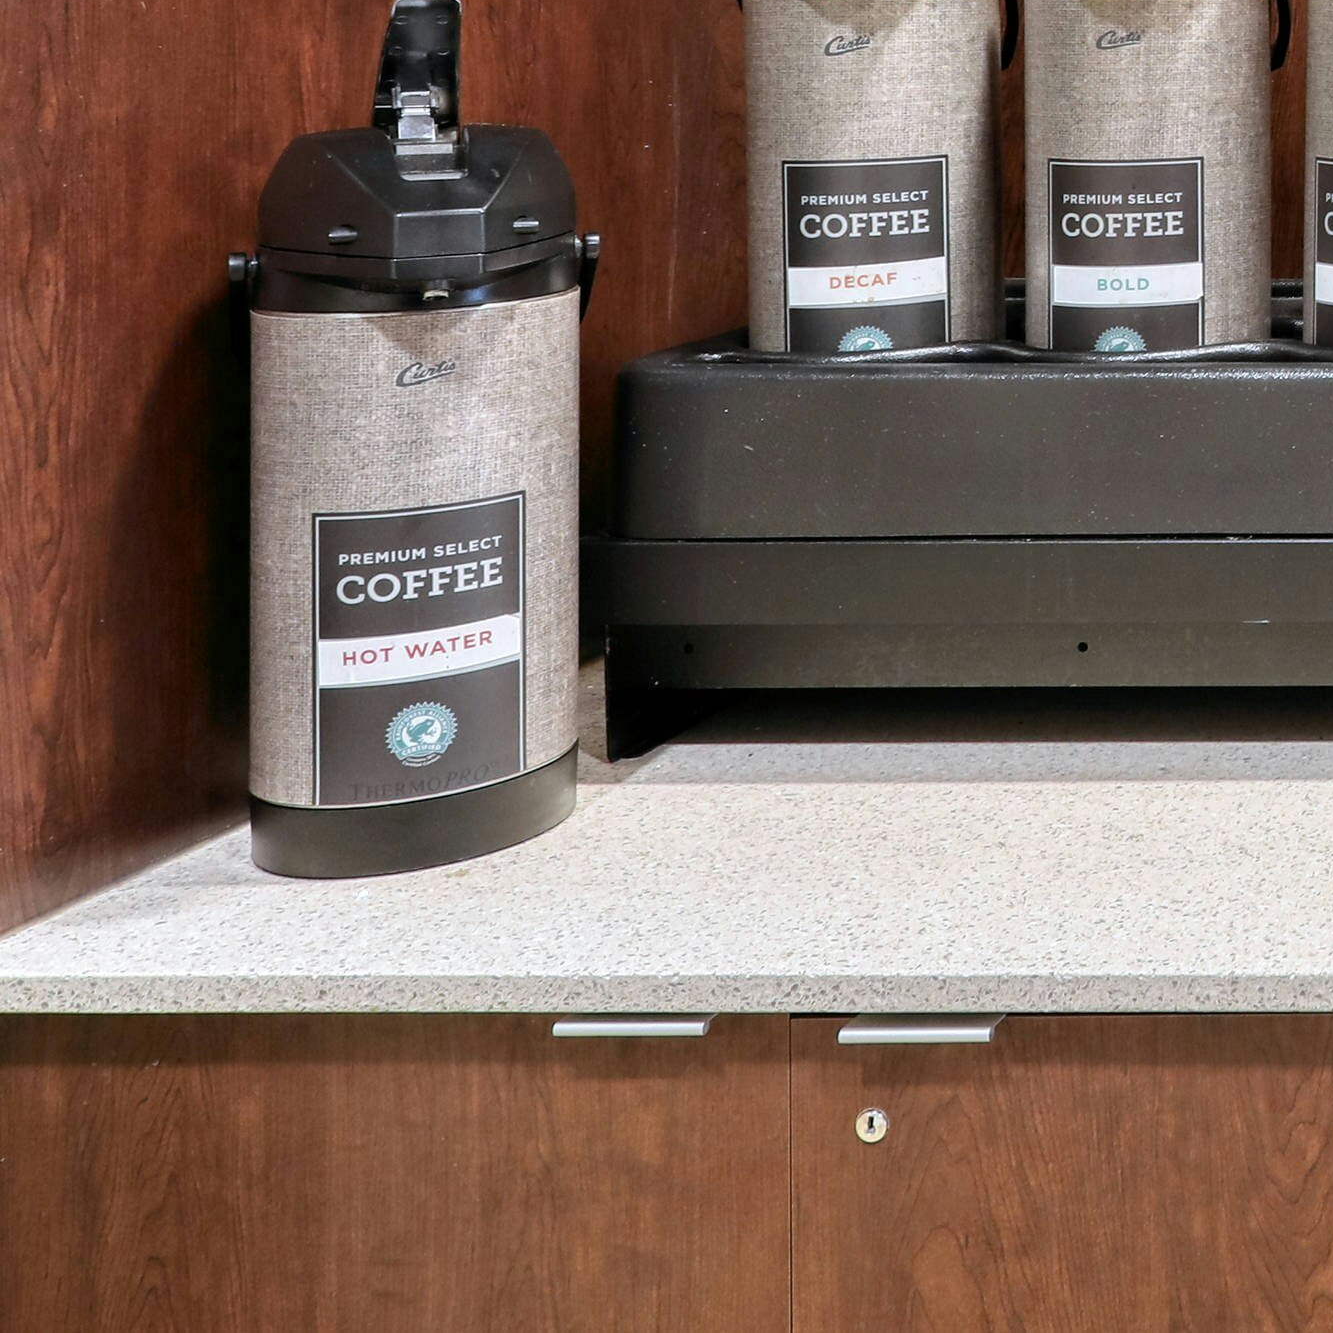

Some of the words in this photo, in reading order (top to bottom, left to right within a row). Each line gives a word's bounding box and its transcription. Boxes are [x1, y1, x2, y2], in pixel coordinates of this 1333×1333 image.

[823, 35, 871, 57] Curtis
[1096, 30, 1142, 50] Curtis
[800, 193, 867, 206] PREMIUM
[872, 190, 929, 204] SELECT
[1062, 193, 1123, 205] PREMIUM
[1127, 192, 1184, 205] SELECT
[799, 208, 931, 239] COFFEE
[1061, 211, 1184, 238] COFFEE
[829, 272, 898, 290] DECAF
[1096, 278, 1150, 292] BOLD
[395, 358, 456, 387] Curtis
[338, 547, 426, 566] PREMIUM
[433, 535, 503, 558] SELECT
[336, 557, 504, 605] COFFEE
[342, 647, 394, 666] HOT
[404, 630, 493, 659] WATER
